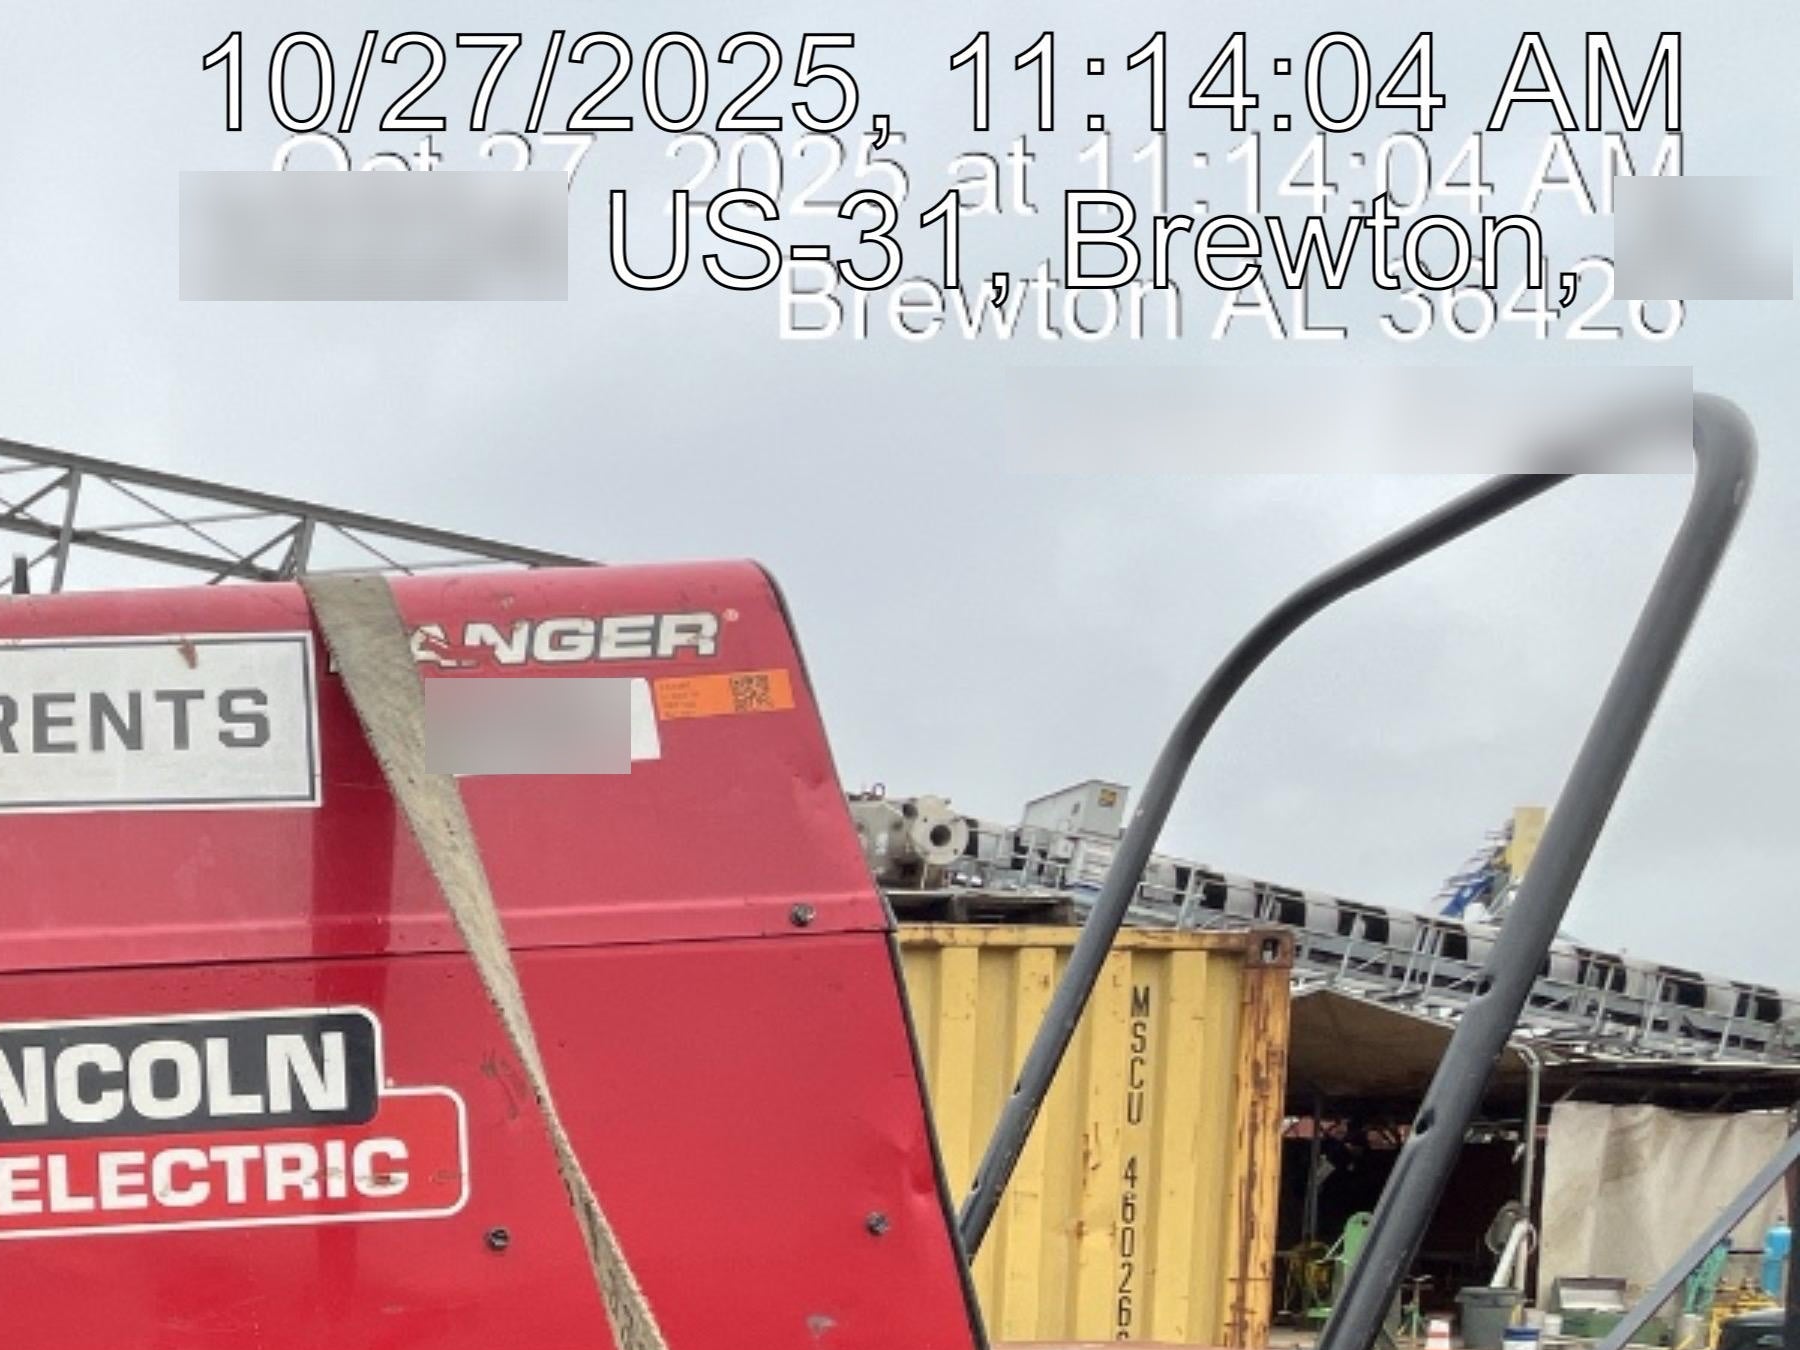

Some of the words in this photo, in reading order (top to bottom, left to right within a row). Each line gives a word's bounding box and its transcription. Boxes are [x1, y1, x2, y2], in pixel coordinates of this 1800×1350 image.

[403, 609, 722, 670] ANGER
[1126, 985, 1151, 1126] MSCU
[1115, 1156, 1138, 1341] 46026
